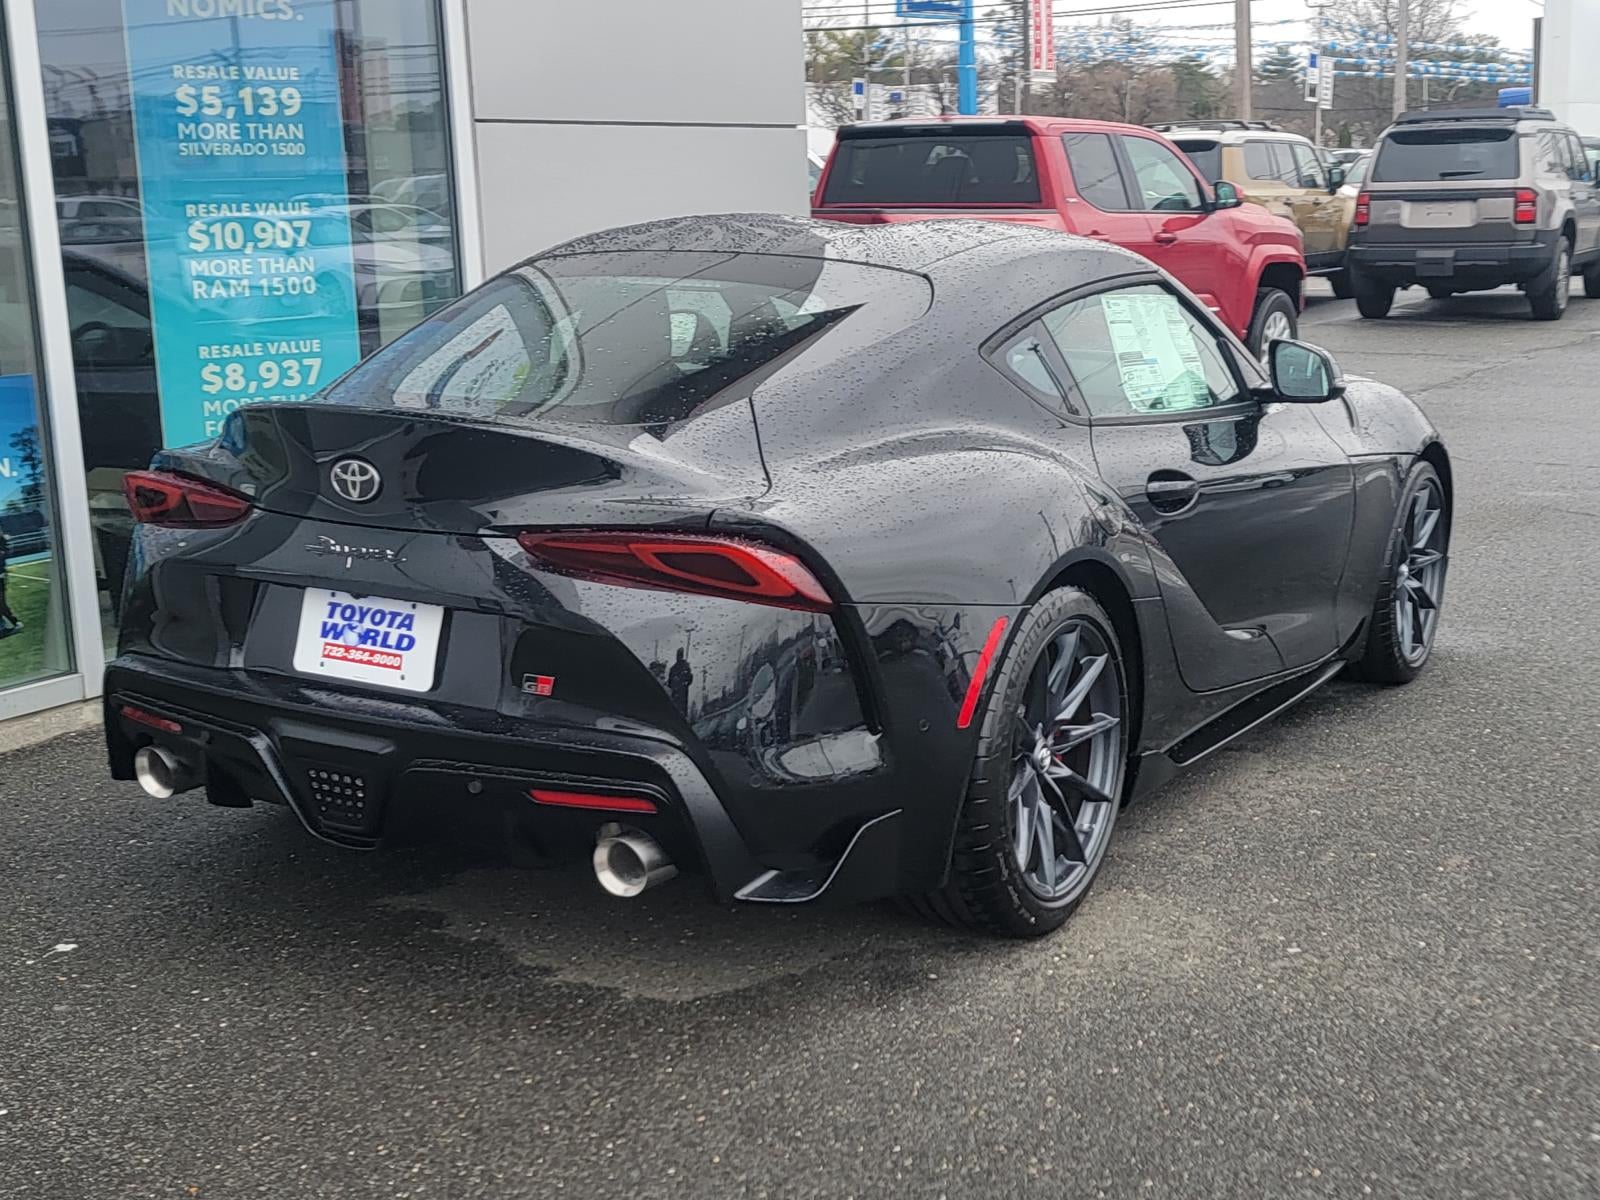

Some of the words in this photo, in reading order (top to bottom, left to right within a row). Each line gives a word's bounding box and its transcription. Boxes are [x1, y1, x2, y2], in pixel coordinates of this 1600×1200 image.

[172, 65, 240, 80] RESALE
[243, 66, 299, 81] VALUE
[175, 83, 302, 120] $5,139
[177, 122, 241, 140] MORE
[245, 123, 304, 140] THAN
[179, 142, 268, 156] SILVERADO
[271, 142, 306, 156] 1500
[185, 203, 250, 218] RESALE
[254, 202, 311, 216] VALUE
[188, 220, 312, 255] $10,907
[190, 259, 253, 277] MORE
[257, 256, 315, 275] THAN
[192, 279, 250, 300] RAM
[259, 275, 317, 297] 1500
[198, 342, 264, 360] RESALE
[266, 339, 321, 355] VALUE
[201, 357, 322, 394] $8,937
[327, 601, 416, 632] TOYOTA
[320, 621, 416, 652] WORLD
